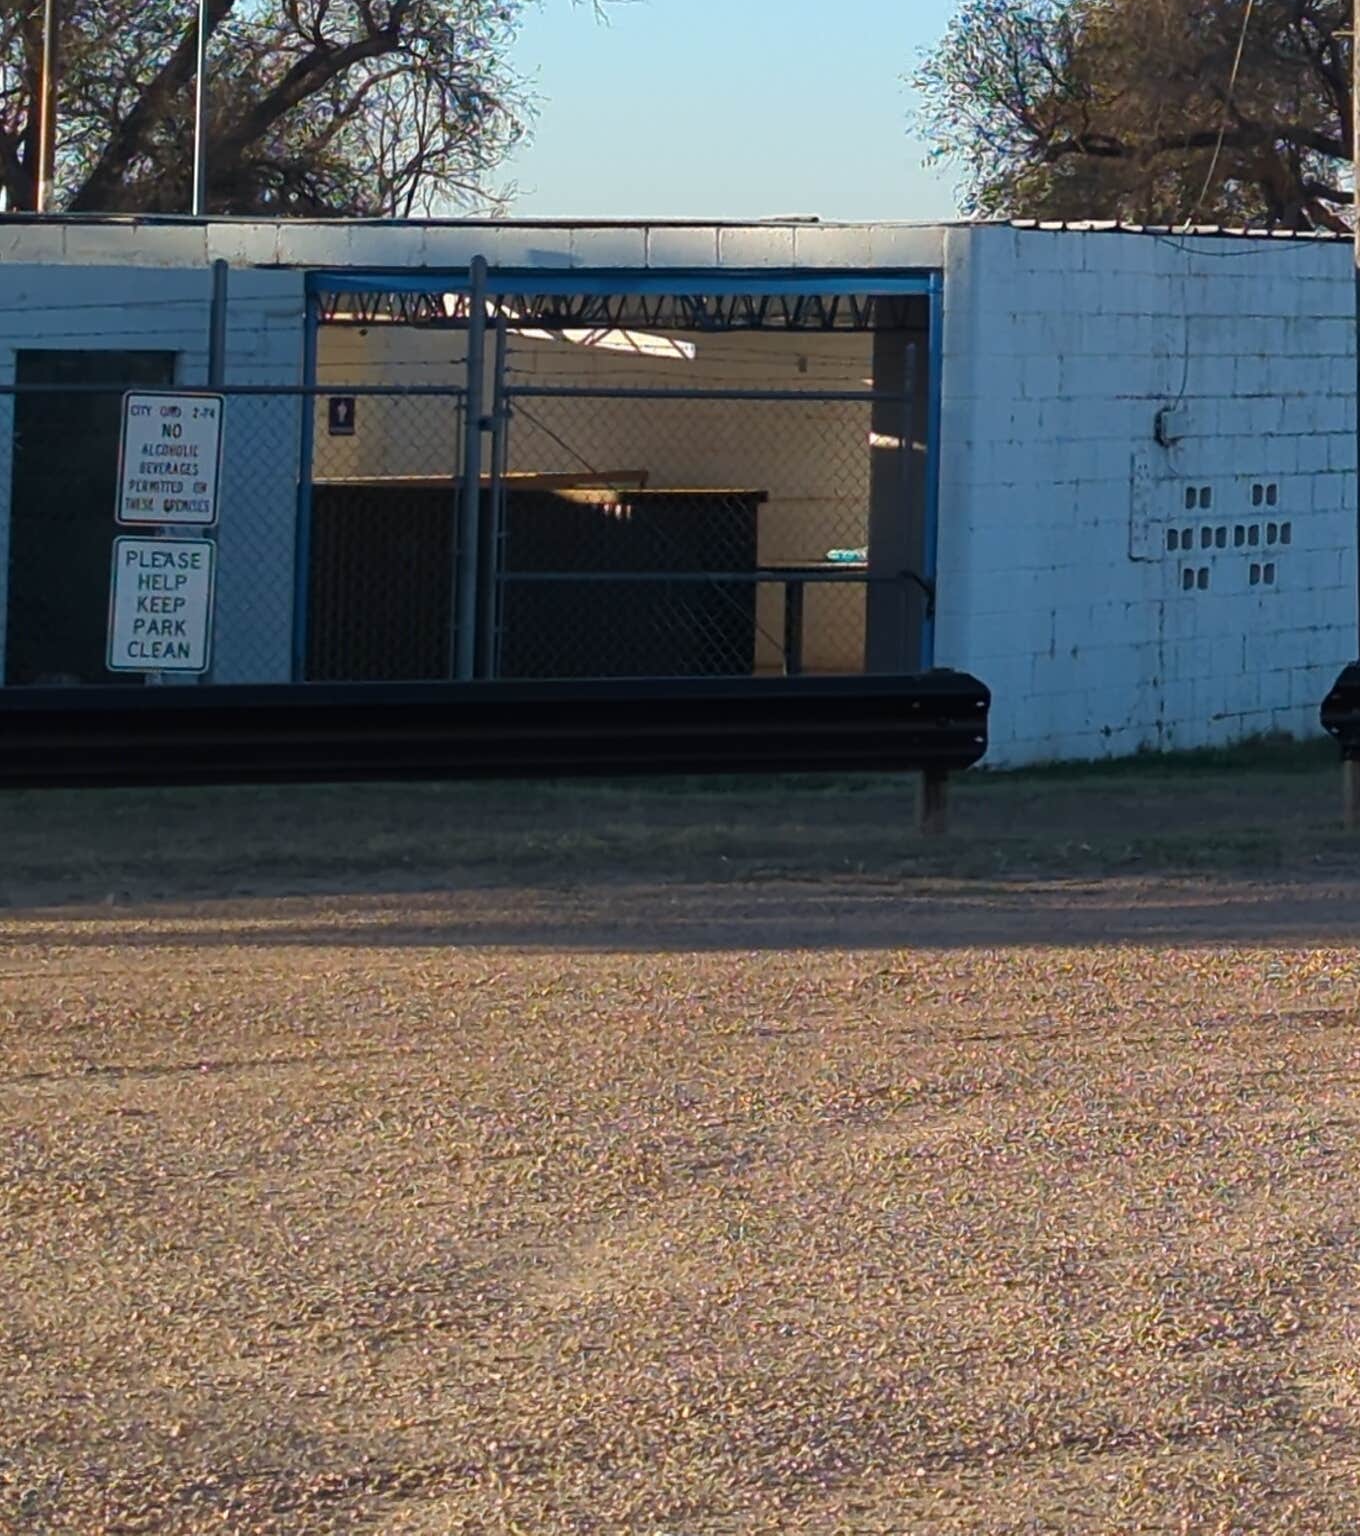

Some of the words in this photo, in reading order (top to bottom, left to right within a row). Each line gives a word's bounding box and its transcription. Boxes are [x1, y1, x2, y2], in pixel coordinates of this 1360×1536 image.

[161, 423, 182, 438] NO
[141, 443, 199, 457] ALCOHOLIC
[140, 462, 199, 475] BEVERAGES
[129, 480, 183, 493] PERMITTED
[126, 550, 201, 569] PLEASE
[138, 573, 187, 591] HELP
[137, 596, 186, 613] KEEP
[133, 618, 186, 636] PARK
[127, 640, 191, 659] CLEAN
